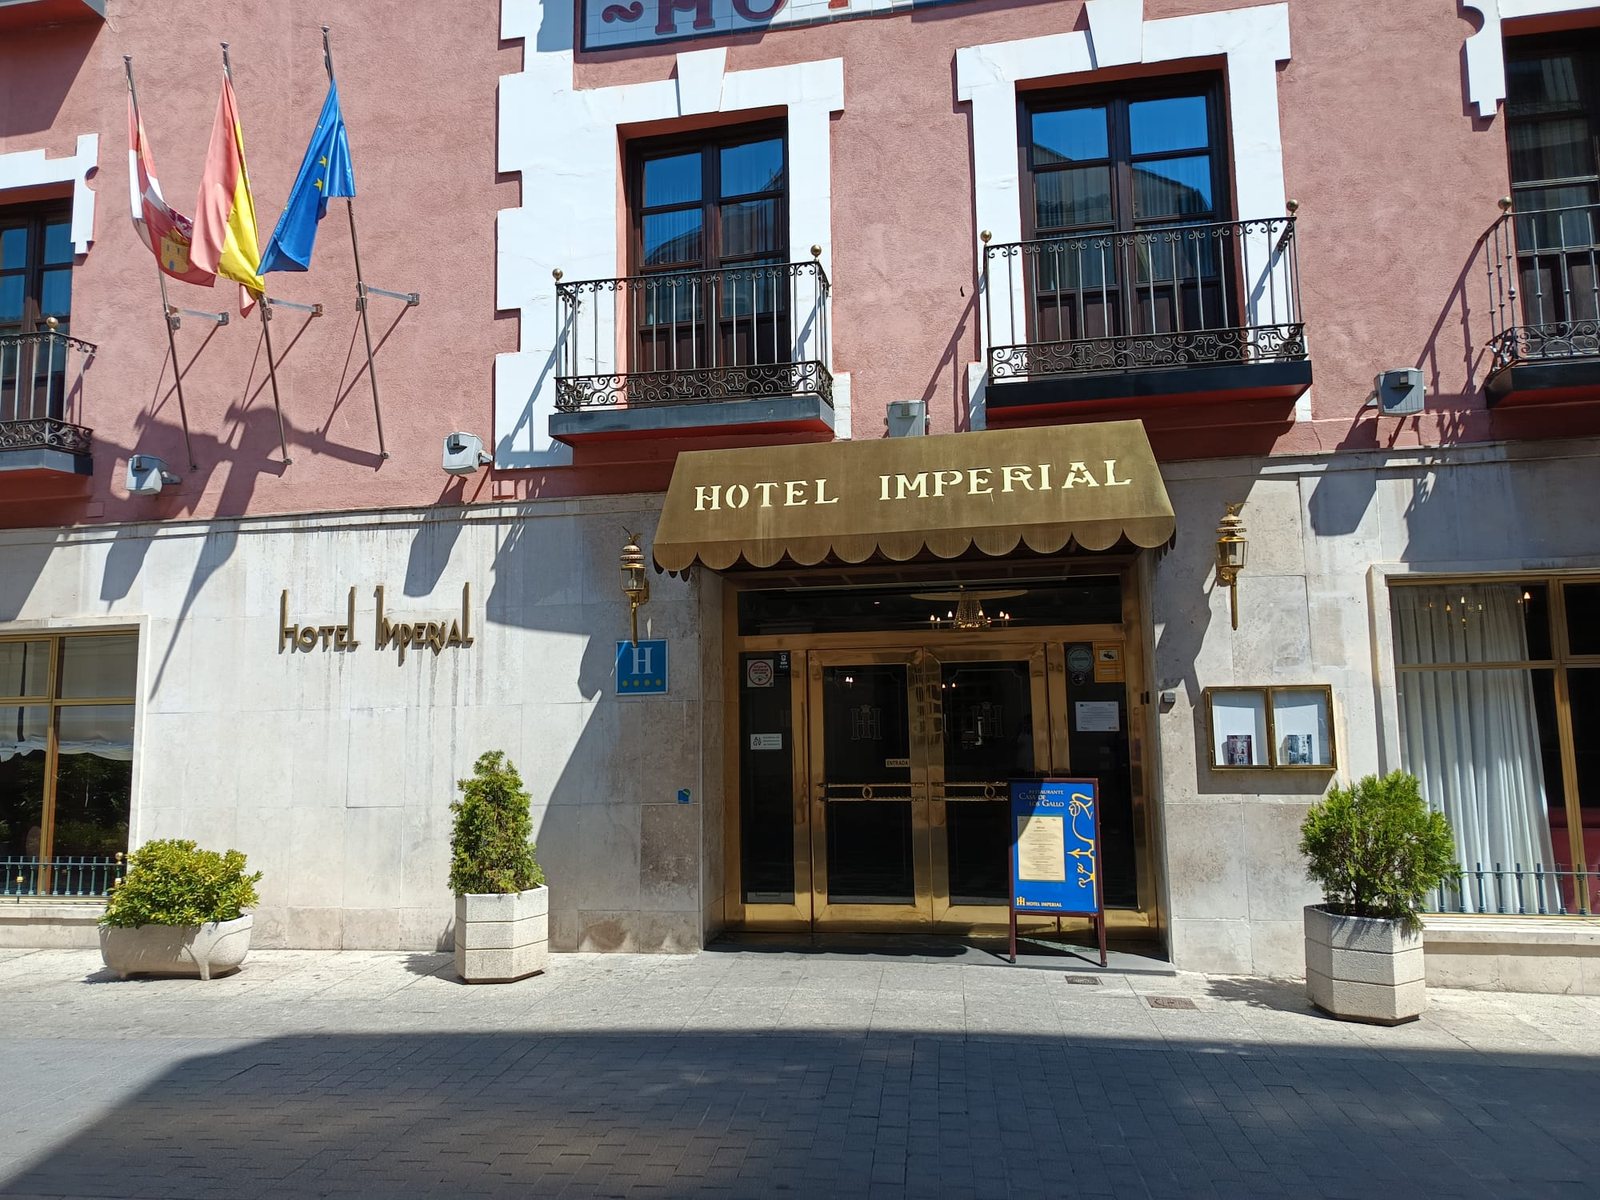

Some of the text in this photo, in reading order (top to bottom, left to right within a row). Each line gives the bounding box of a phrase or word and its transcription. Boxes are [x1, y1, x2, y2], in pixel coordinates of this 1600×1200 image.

[693, 458, 1132, 512] HOTEL IMPERIAL
[278, 586, 360, 654] HOTEL
[630, 647, 653, 675] H
